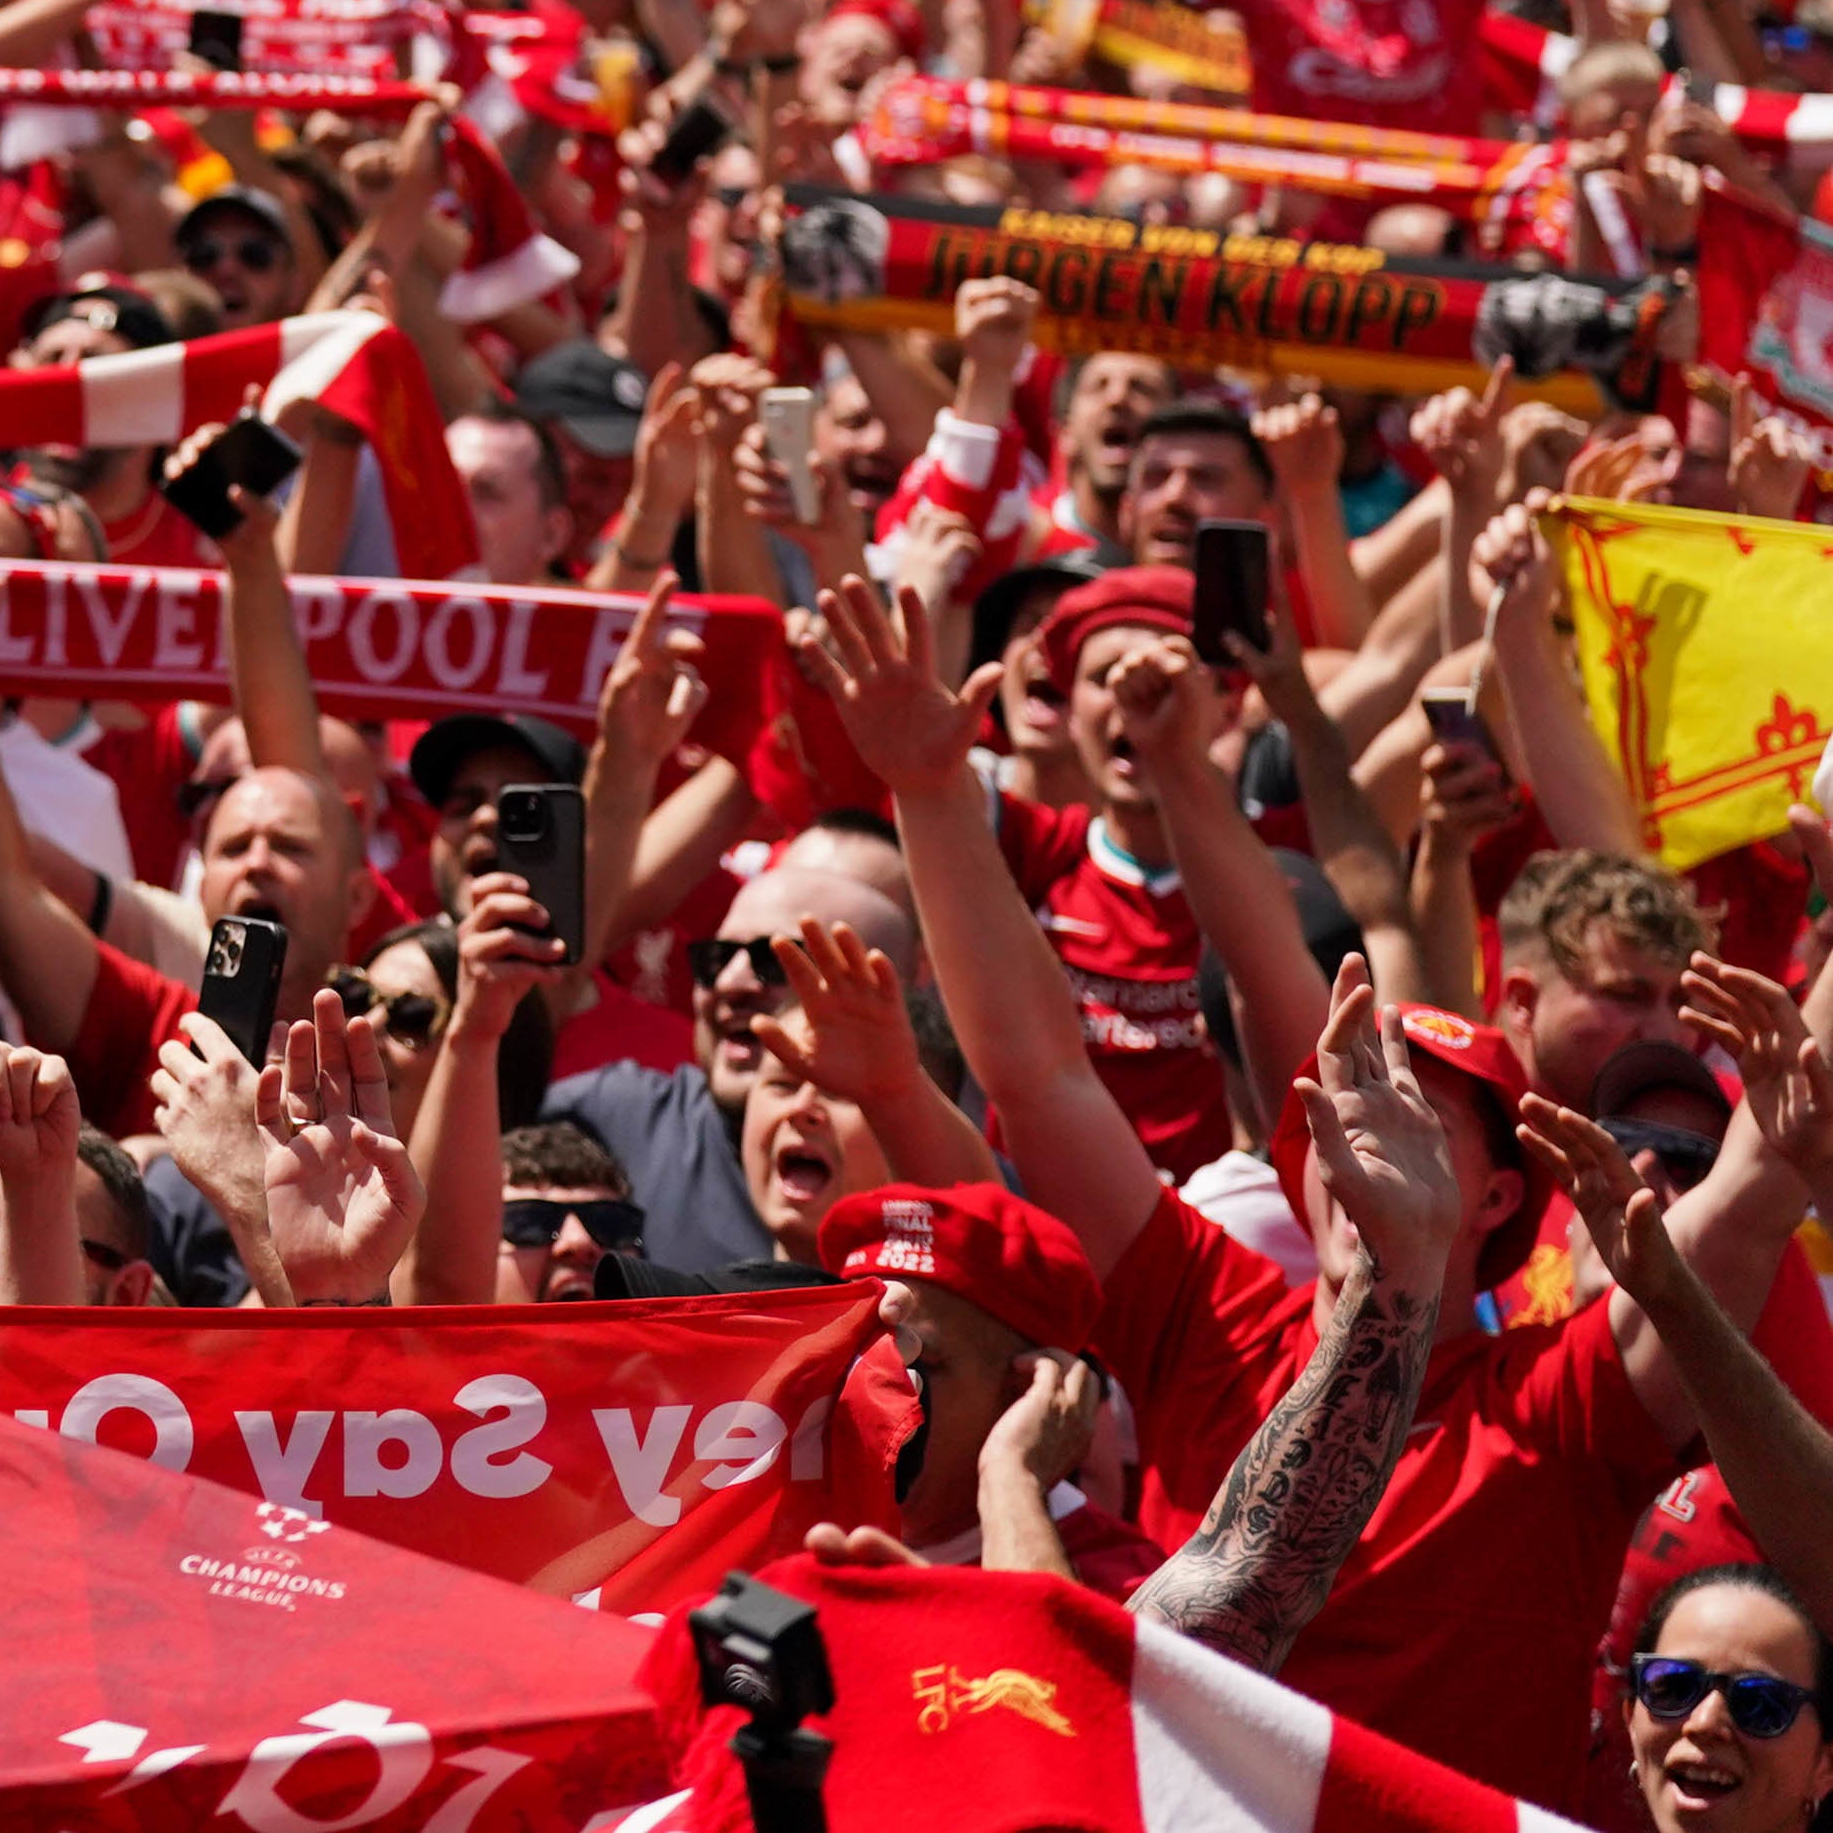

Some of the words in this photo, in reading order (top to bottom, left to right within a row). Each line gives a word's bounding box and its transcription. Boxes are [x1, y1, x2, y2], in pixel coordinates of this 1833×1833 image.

[1205, 258, 1448, 350] KLOPP
[875, 1249, 935, 1274] 2022
[179, 1554, 348, 1600] CHAMPIONS
[911, 1664, 949, 1735] LFC
